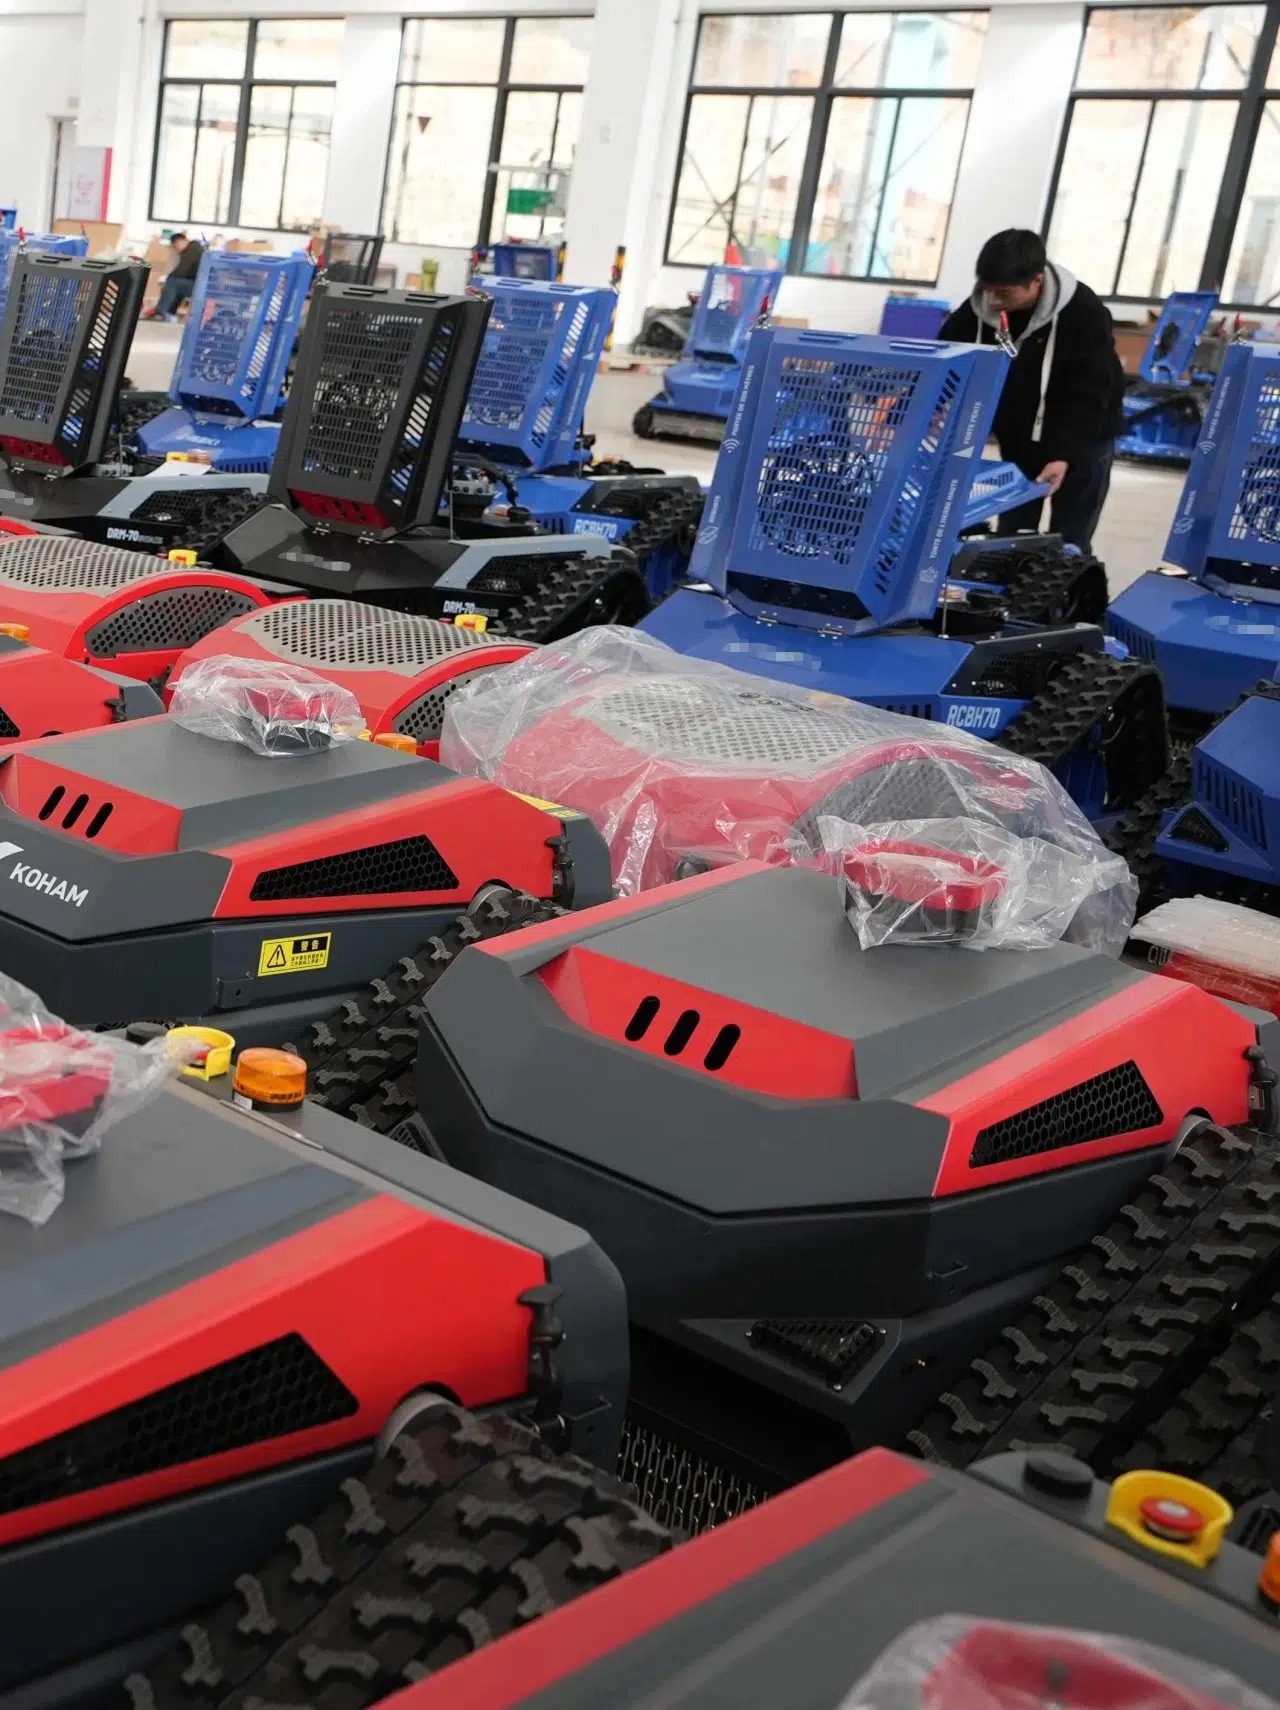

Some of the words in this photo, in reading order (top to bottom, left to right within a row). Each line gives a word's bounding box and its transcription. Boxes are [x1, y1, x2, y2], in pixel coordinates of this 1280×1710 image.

[107, 527, 139, 541] DRM-70
[443, 600, 475, 614] DRM-70
[947, 705, 1001, 728] RCBH70
[9, 862, 89, 907] KOHAM
